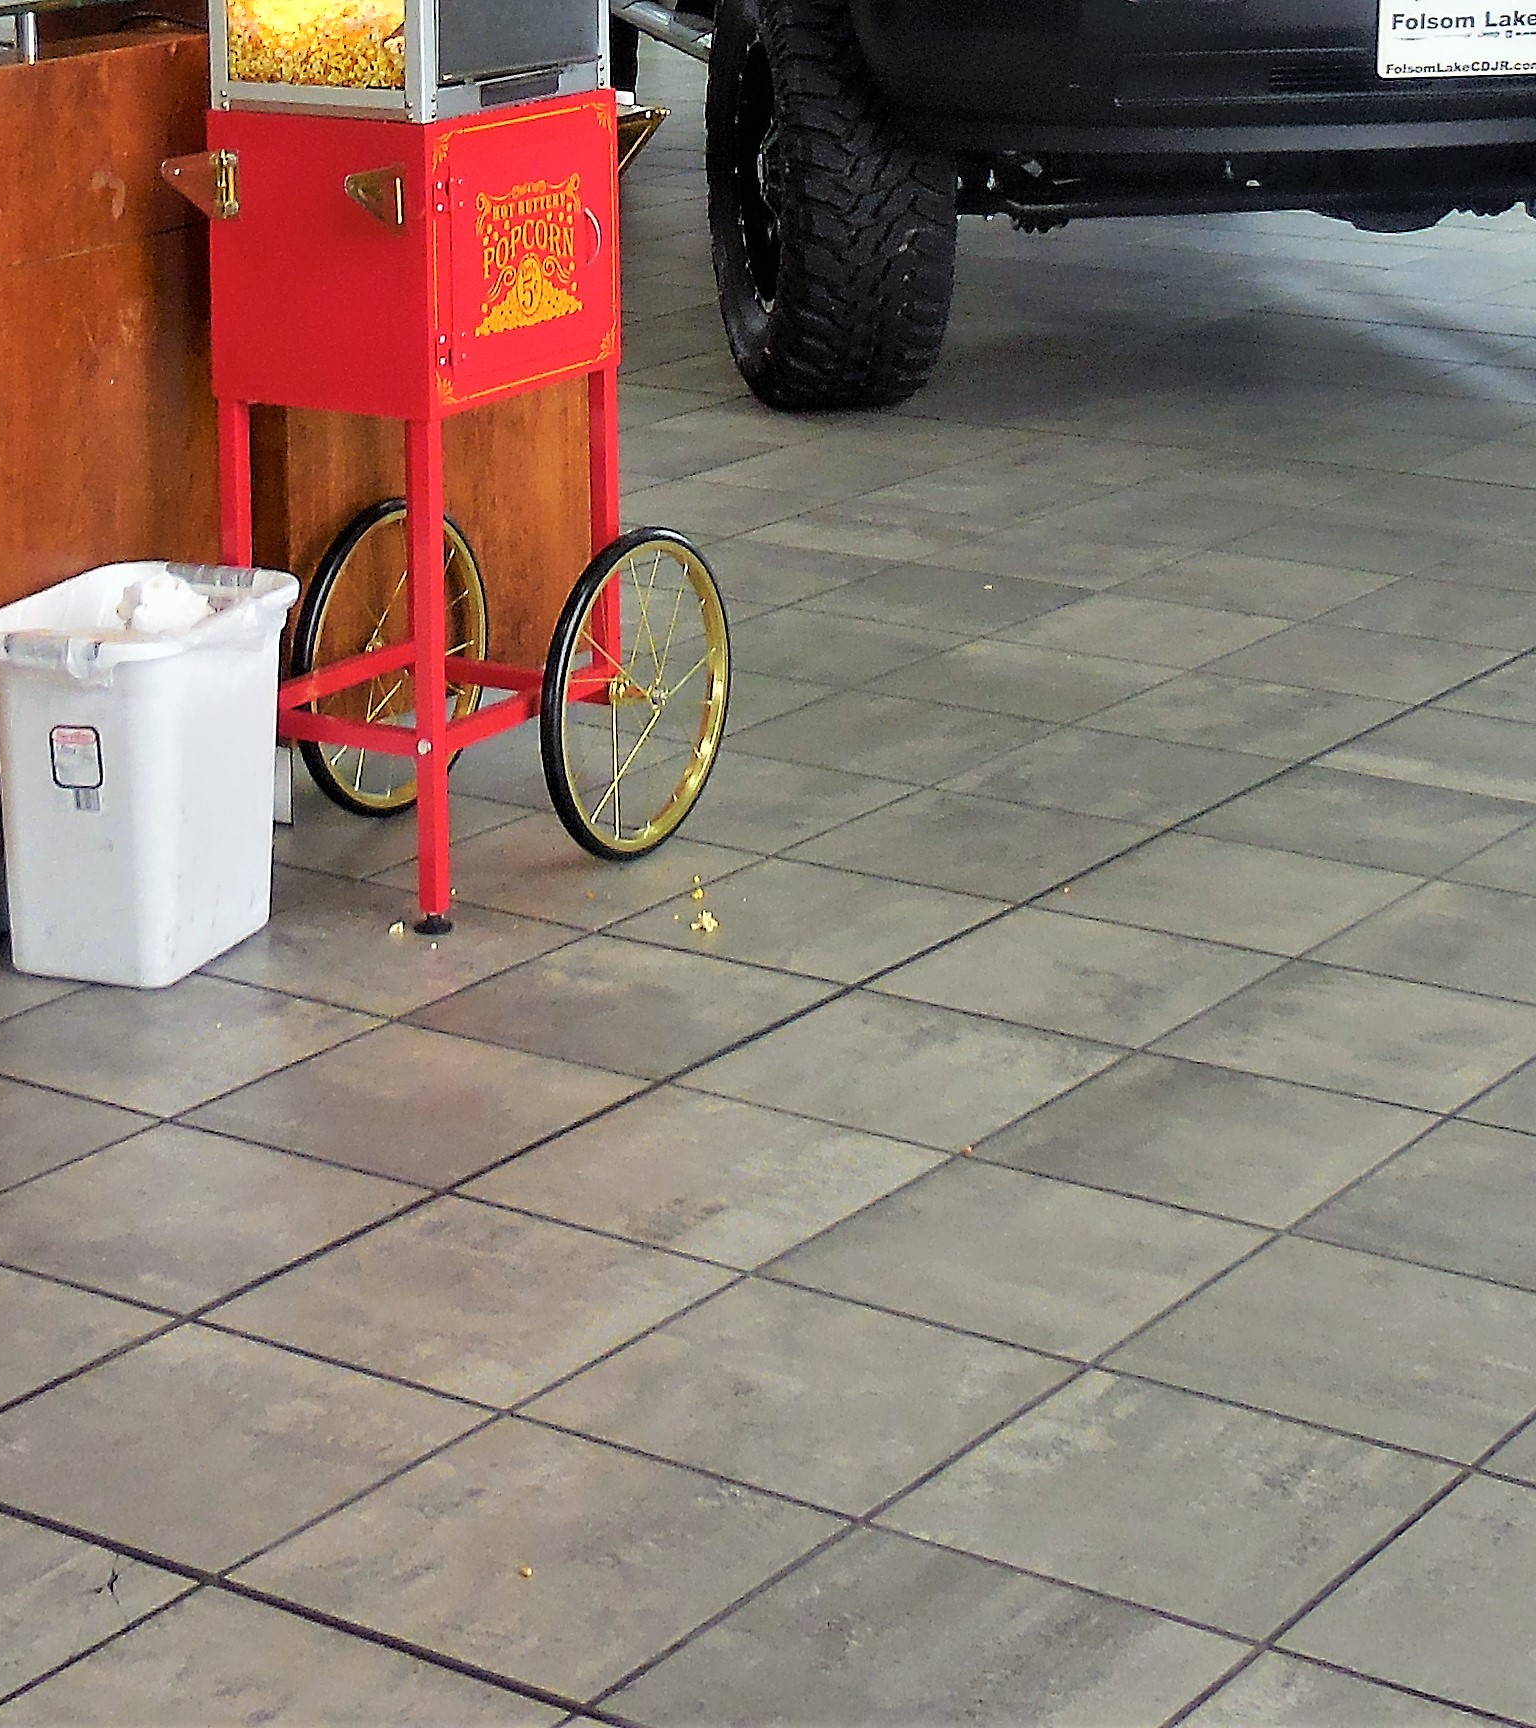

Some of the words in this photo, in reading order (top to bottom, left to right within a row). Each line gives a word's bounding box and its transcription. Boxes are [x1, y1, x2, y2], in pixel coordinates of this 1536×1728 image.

[1392, 14, 1475, 30] Folsom
[493, 203, 514, 221] HOT
[518, 193, 566, 216] BUTTERY
[484, 220, 574, 279] POPCORN
